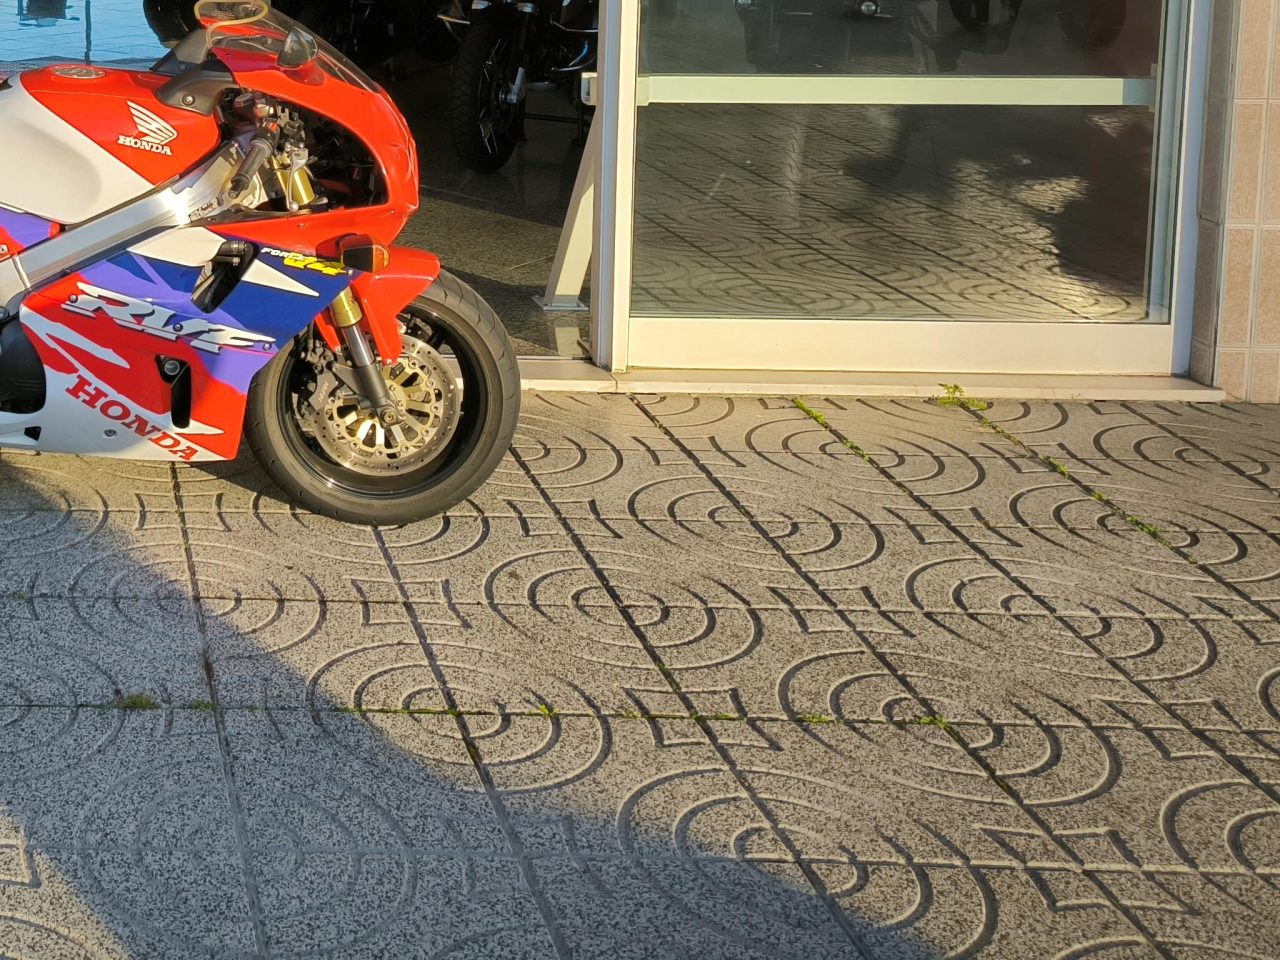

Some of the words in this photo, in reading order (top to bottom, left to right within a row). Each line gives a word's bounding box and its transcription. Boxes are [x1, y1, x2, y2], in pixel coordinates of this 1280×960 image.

[117, 134, 173, 156] HONDA
[61, 281, 276, 353] RVF
[65, 374, 200, 461] HONDA
